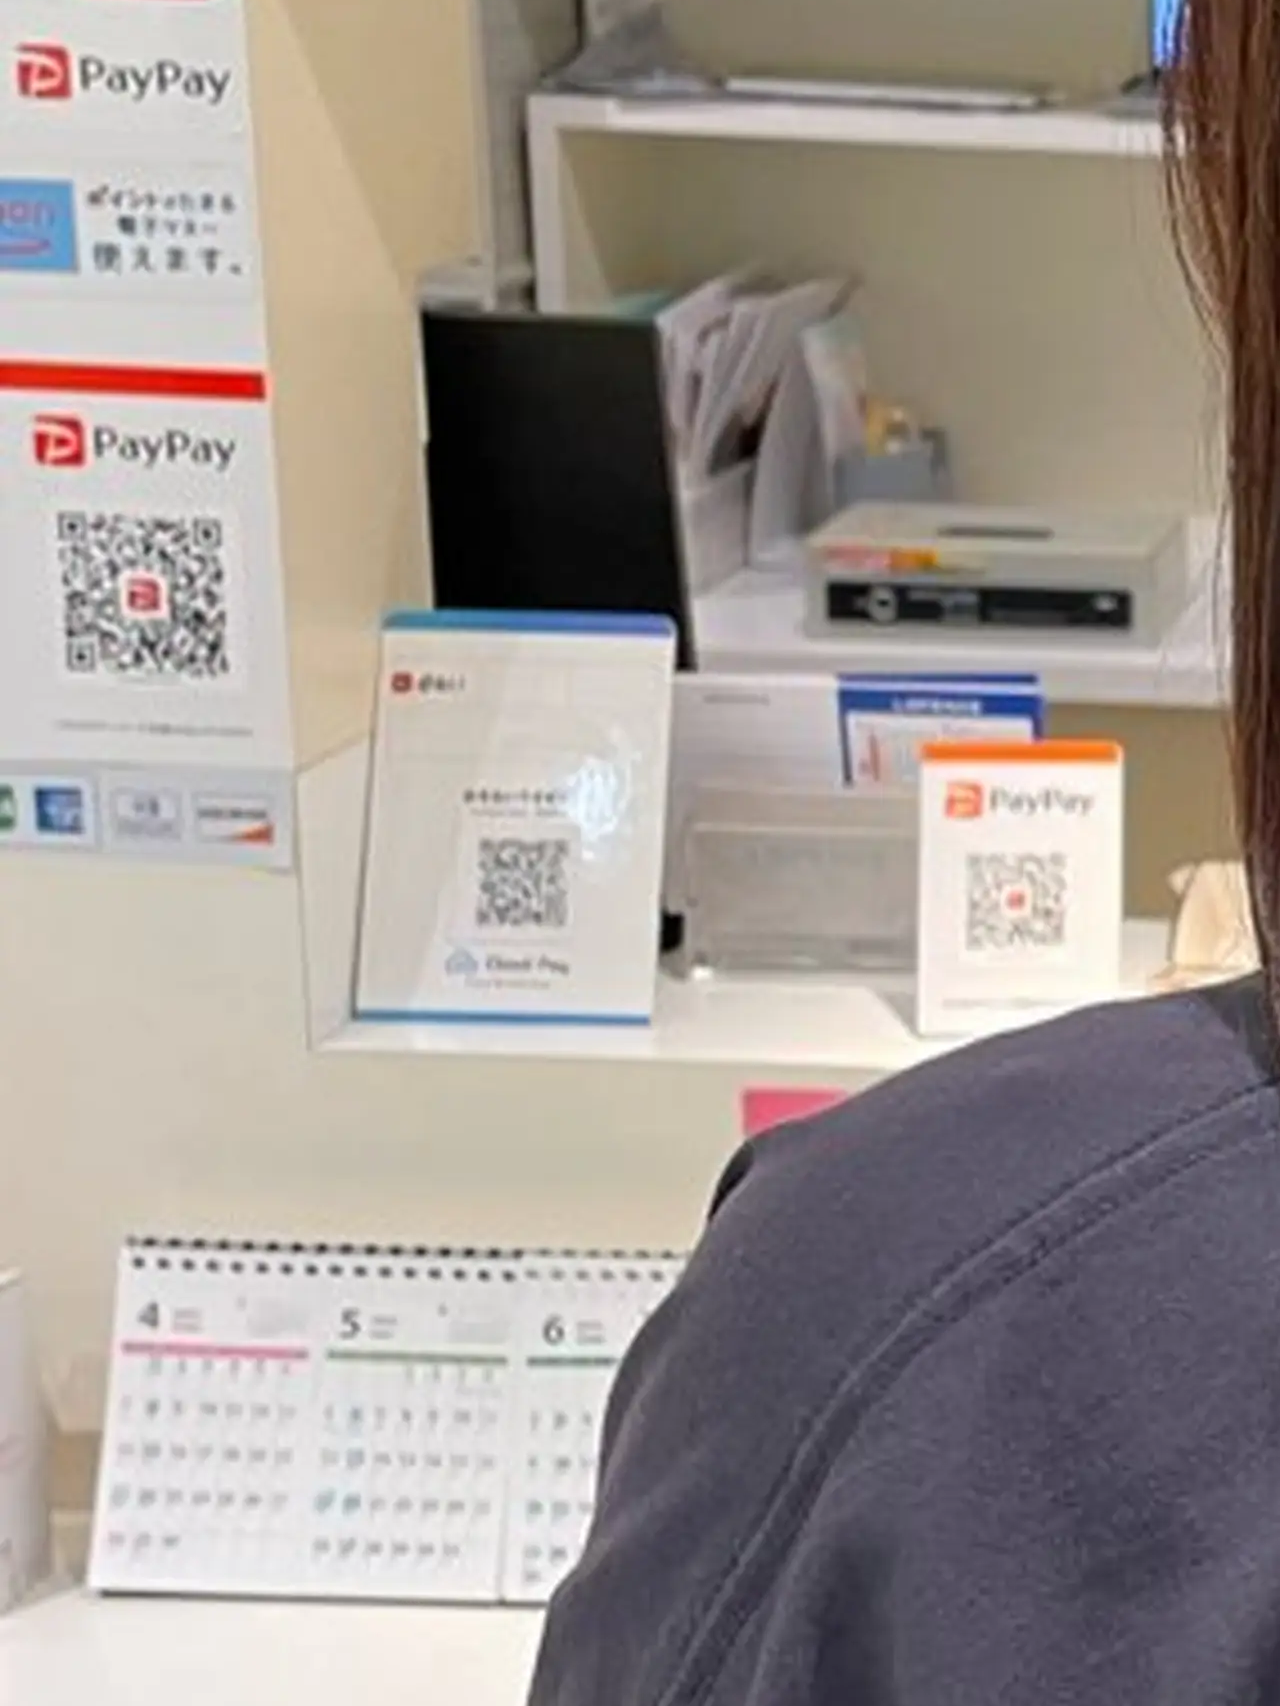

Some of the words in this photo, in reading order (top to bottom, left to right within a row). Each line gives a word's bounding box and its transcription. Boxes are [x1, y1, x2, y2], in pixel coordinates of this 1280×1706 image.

[79, 55, 231, 106] PayPay
[92, 424, 236, 472] PayPay
[989, 785, 1096, 818] PayPay
[137, 1300, 161, 1330] 4
[340, 1308, 361, 1339] 5
[543, 1316, 564, 1346] 6
